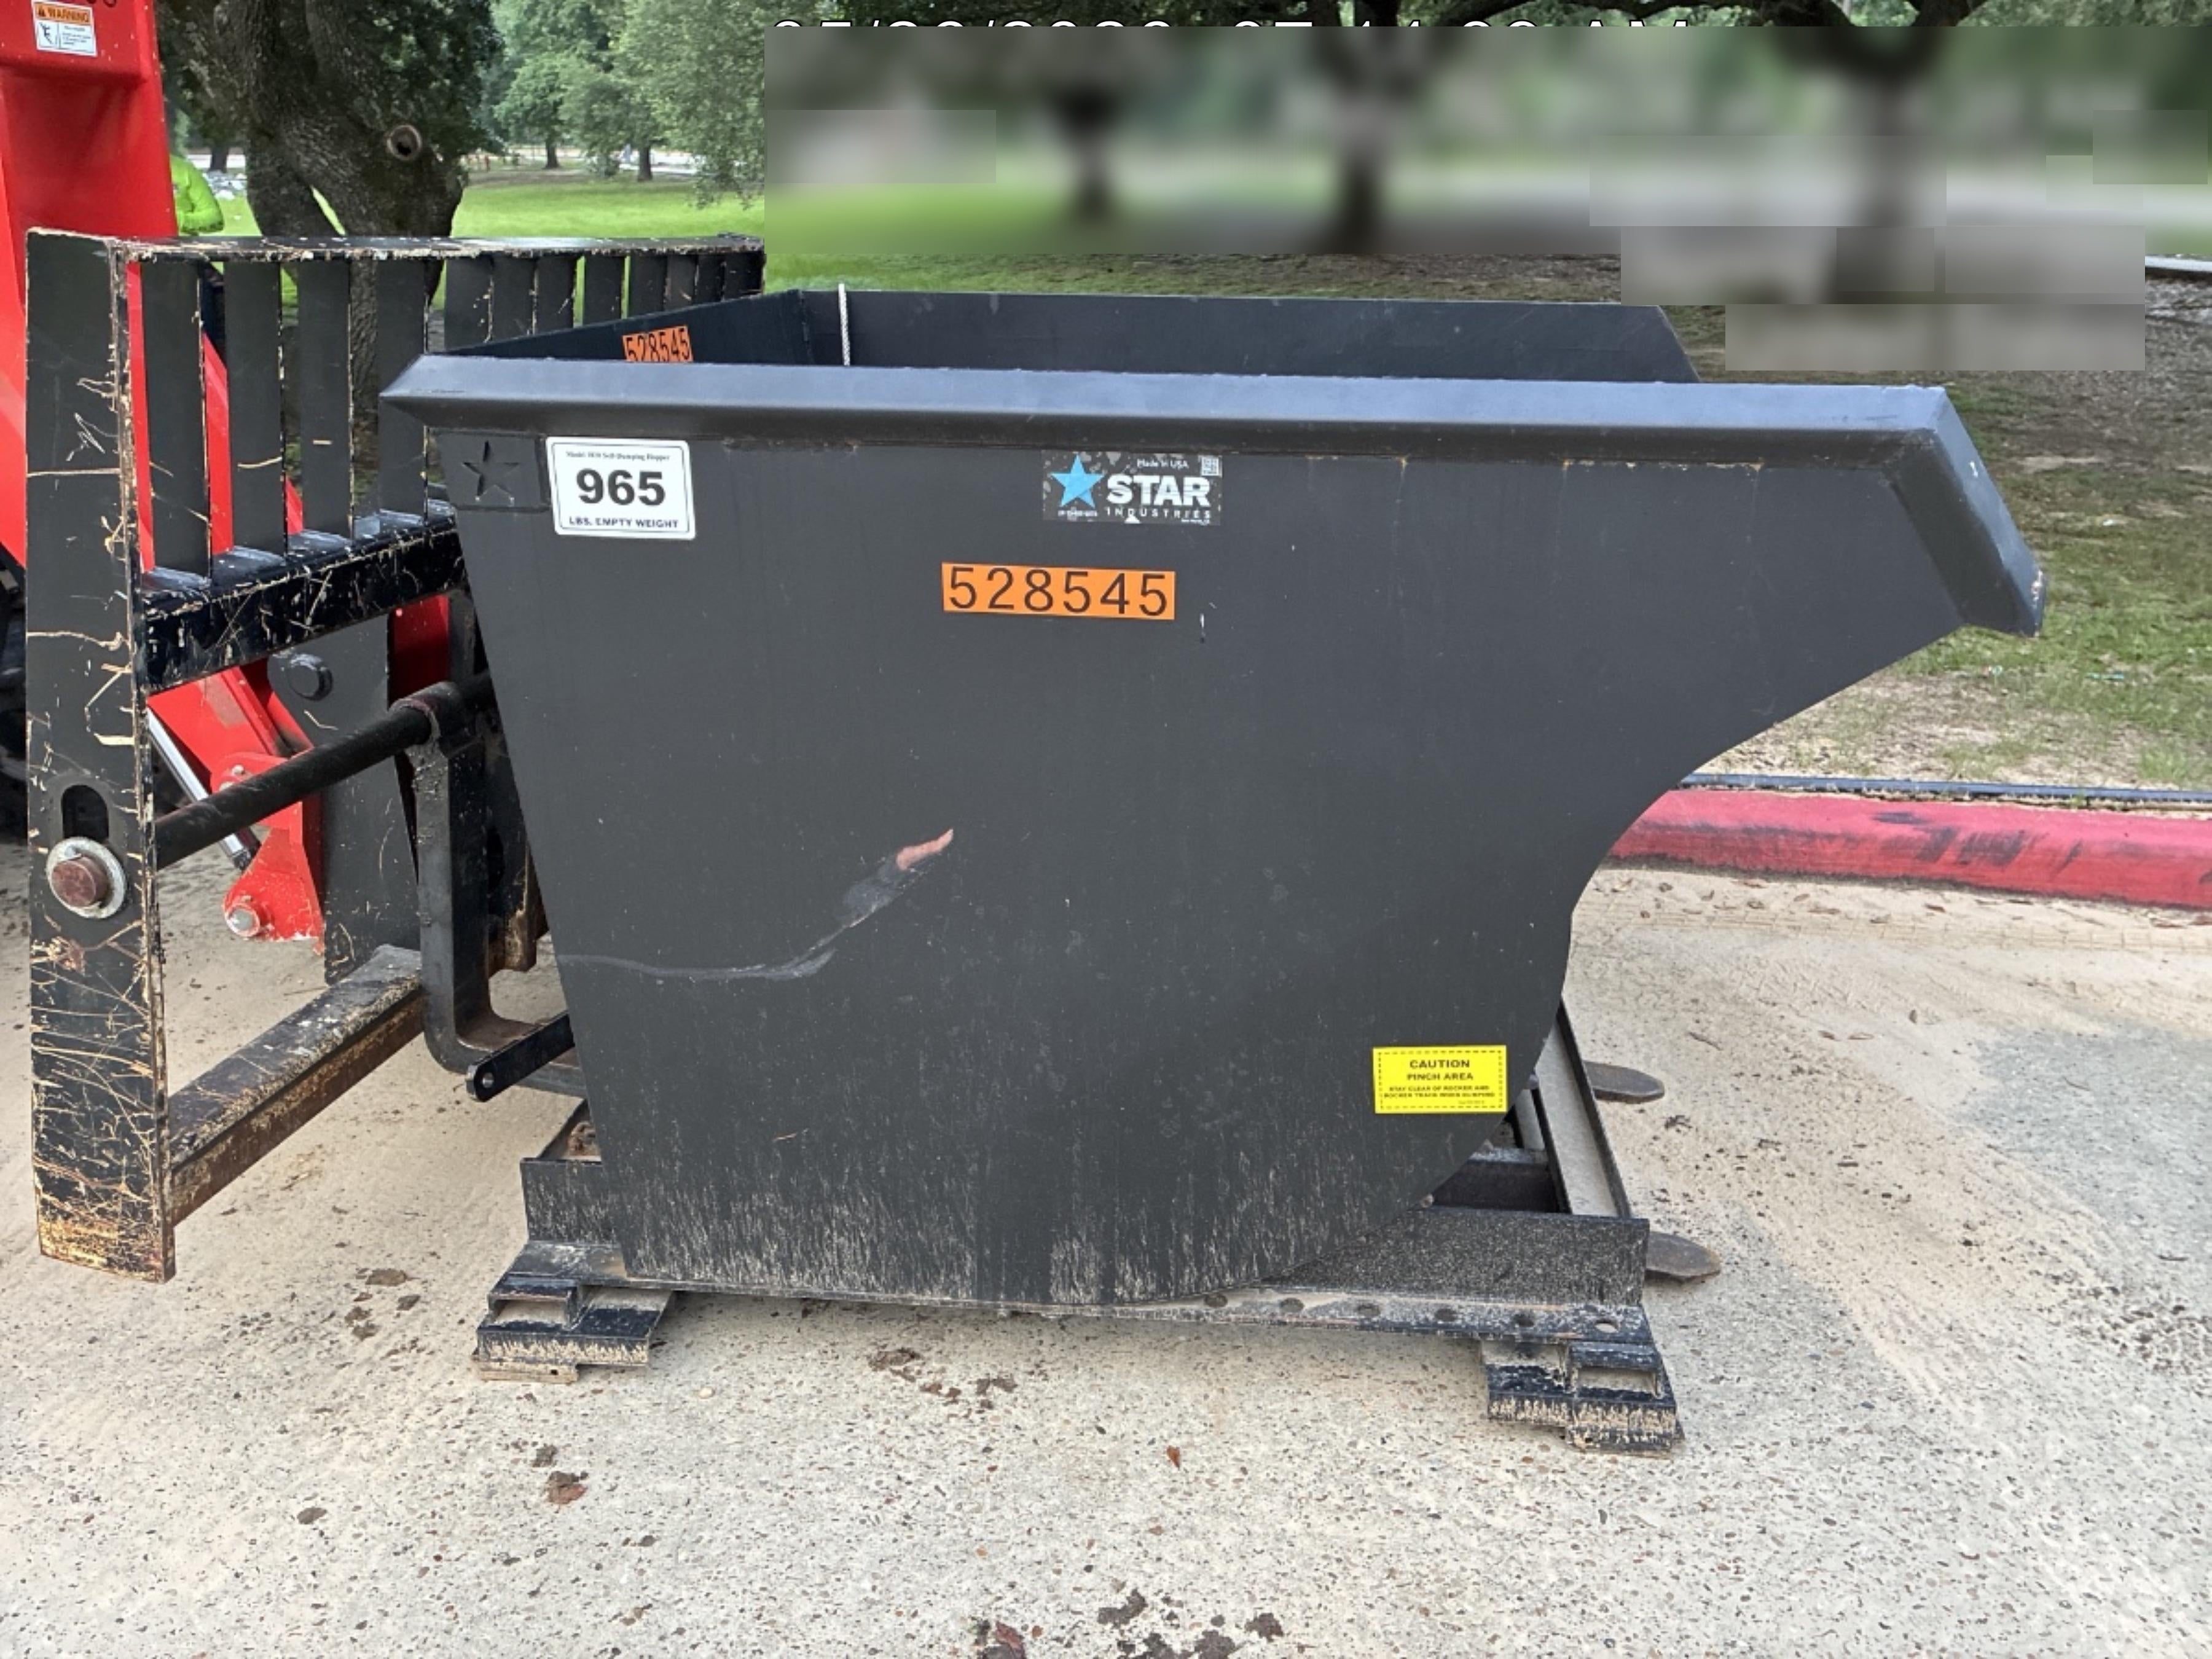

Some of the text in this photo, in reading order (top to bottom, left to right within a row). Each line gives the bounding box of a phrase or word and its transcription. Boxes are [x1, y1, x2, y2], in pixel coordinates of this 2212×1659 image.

[47, 7, 89, 23] WARNING
[1170, 460, 1190, 469] USA
[576, 468, 665, 506] 965
[1107, 474, 1210, 506] STAR
[569, 516, 678, 528] LBS. EMPTY WEIGHT
[949, 567, 1167, 616] 528545
[1410, 1059, 1470, 1068] CAUTION
[1444, 1072, 1473, 1081] AREA
